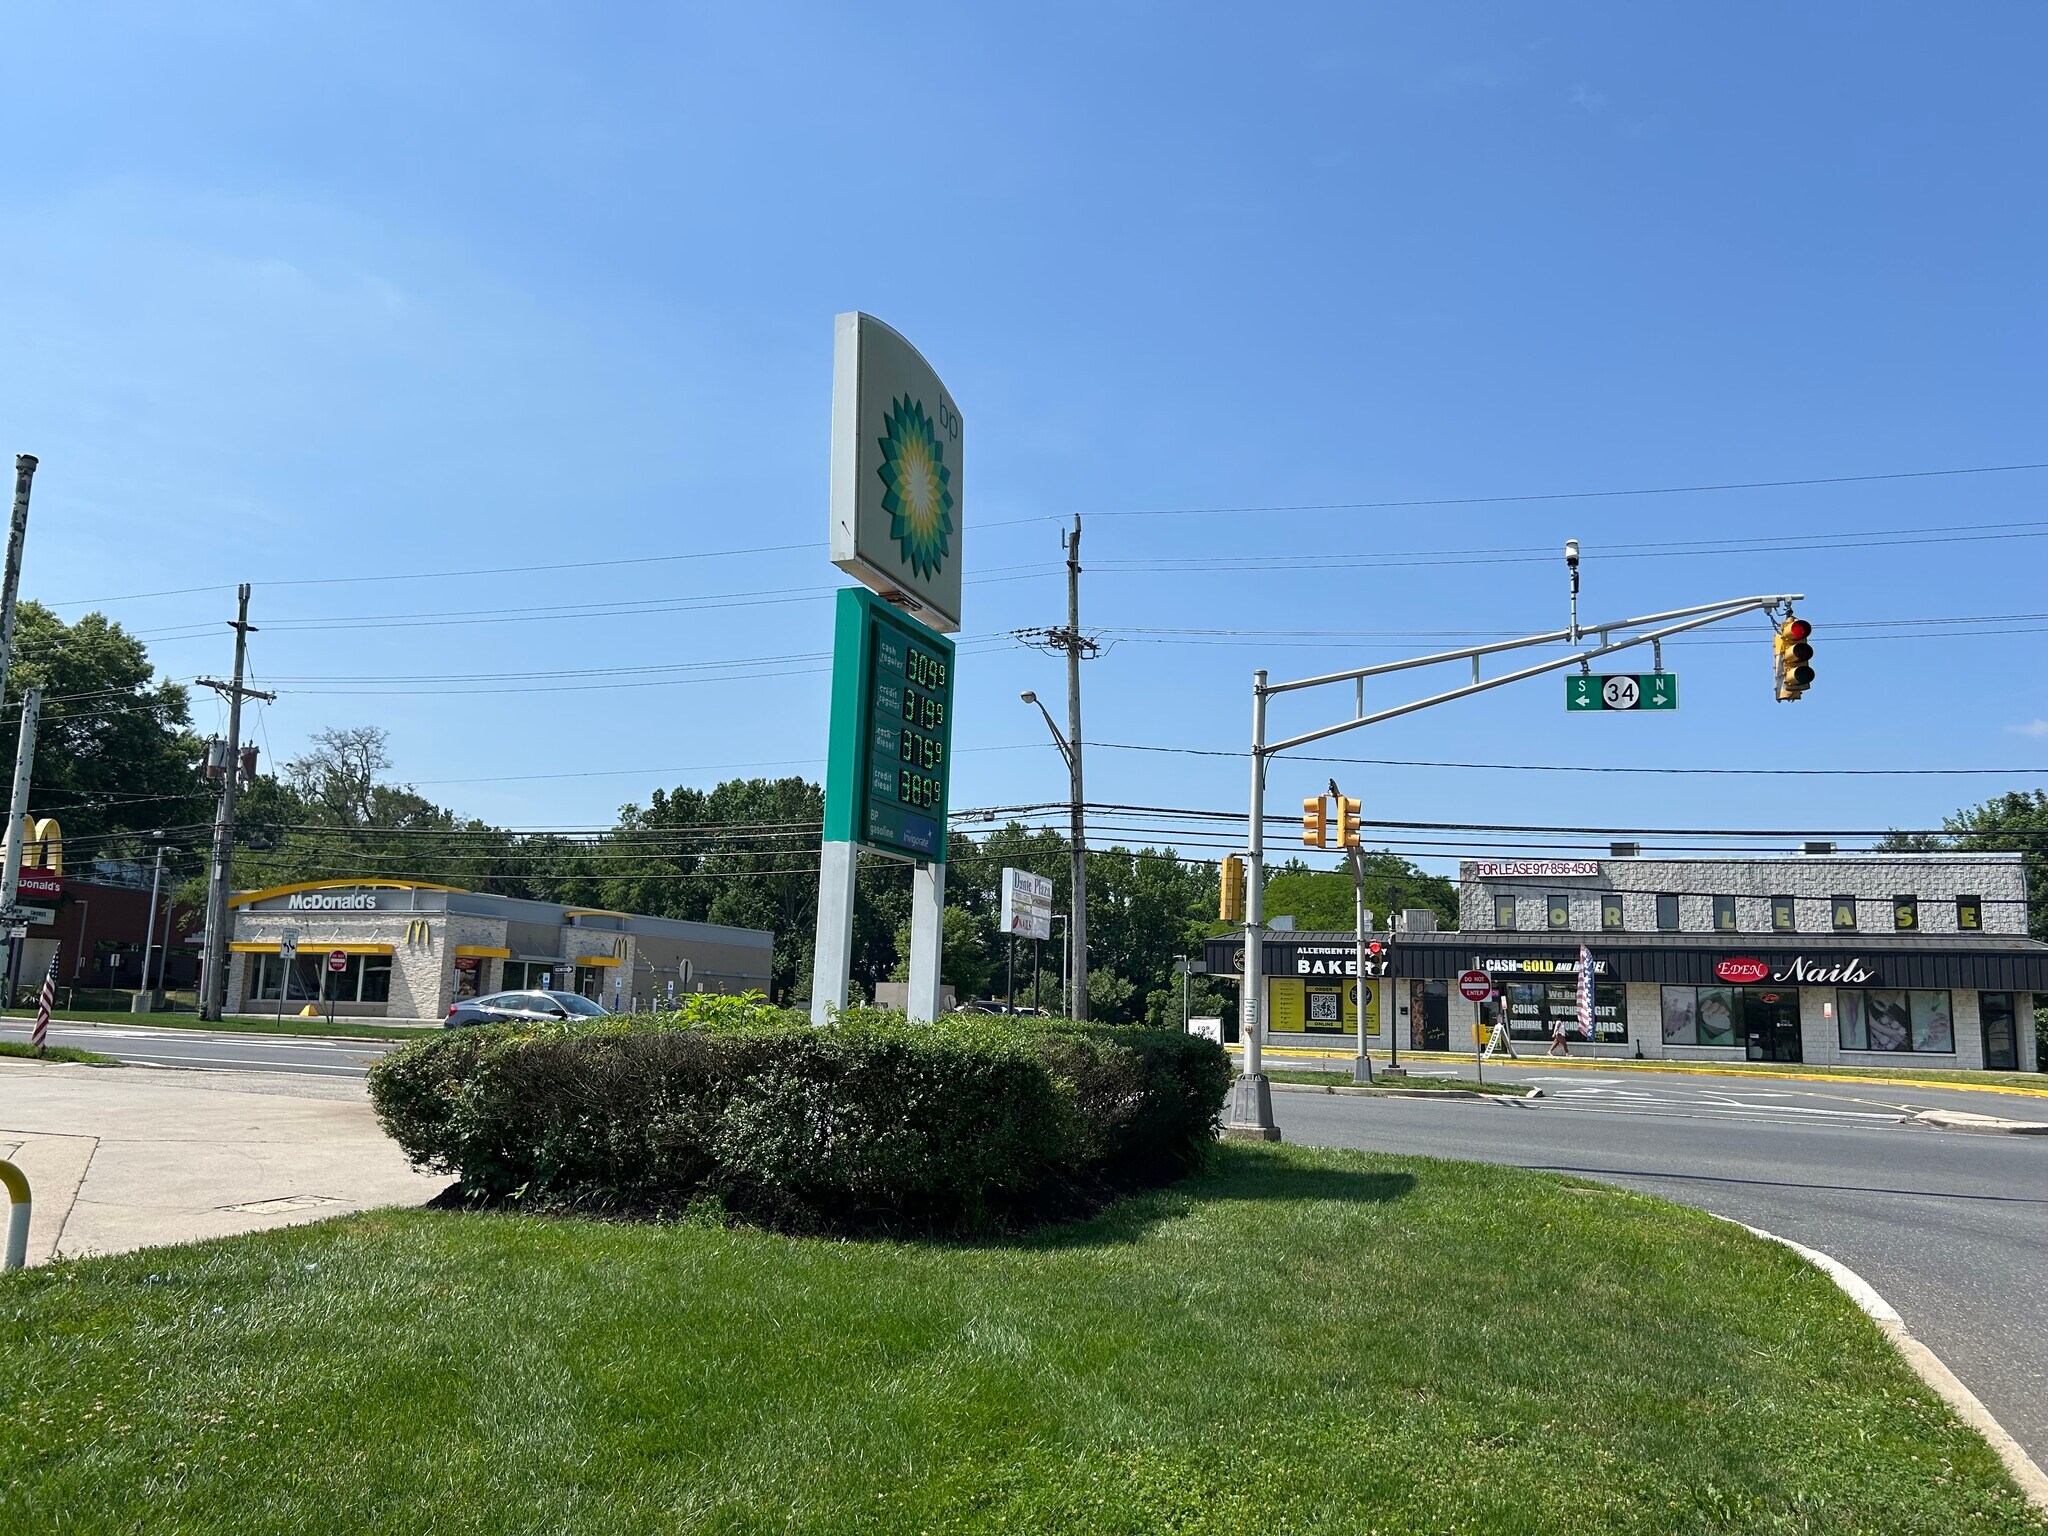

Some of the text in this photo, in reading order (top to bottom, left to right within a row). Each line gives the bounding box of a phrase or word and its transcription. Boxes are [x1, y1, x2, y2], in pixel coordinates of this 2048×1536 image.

[940, 393, 958, 442] bp
[881, 643, 896, 656] cash
[880, 653, 903, 669] regular
[879, 685, 897, 699] credit
[1578, 679, 1664, 702] S 34 N
[878, 695, 900, 709] regular
[877, 728, 891, 739] cash
[876, 737, 895, 750] diesel
[875, 770, 892, 781] credit
[874, 780, 892, 792] diesel
[870, 809, 879, 821] BP
[869, 825, 894, 838] gasoline
[903, 832, 929, 847] Invigorate
[1477, 863, 1498, 875] FOR
[1499, 862, 1533, 875] LEASE
[288, 894, 376, 909] McDonald's
[1297, 946, 1343, 955] ALLERGEN
[1486, 959, 1517, 971] CASH
[1523, 960, 1554, 972] GOLD
[1555, 962, 1573, 972] AND
[1718, 962, 1764, 977] EDEN
[1773, 956, 1875, 983] Nails
[1549, 990, 1563, 998] We
[1512, 1004, 1539, 1014] COINS
[1594, 1006, 1617, 1016] GIFT
[1510, 1020, 1542, 1030] SILVERWARE
[1595, 1022, 1624, 1033] ARDS
